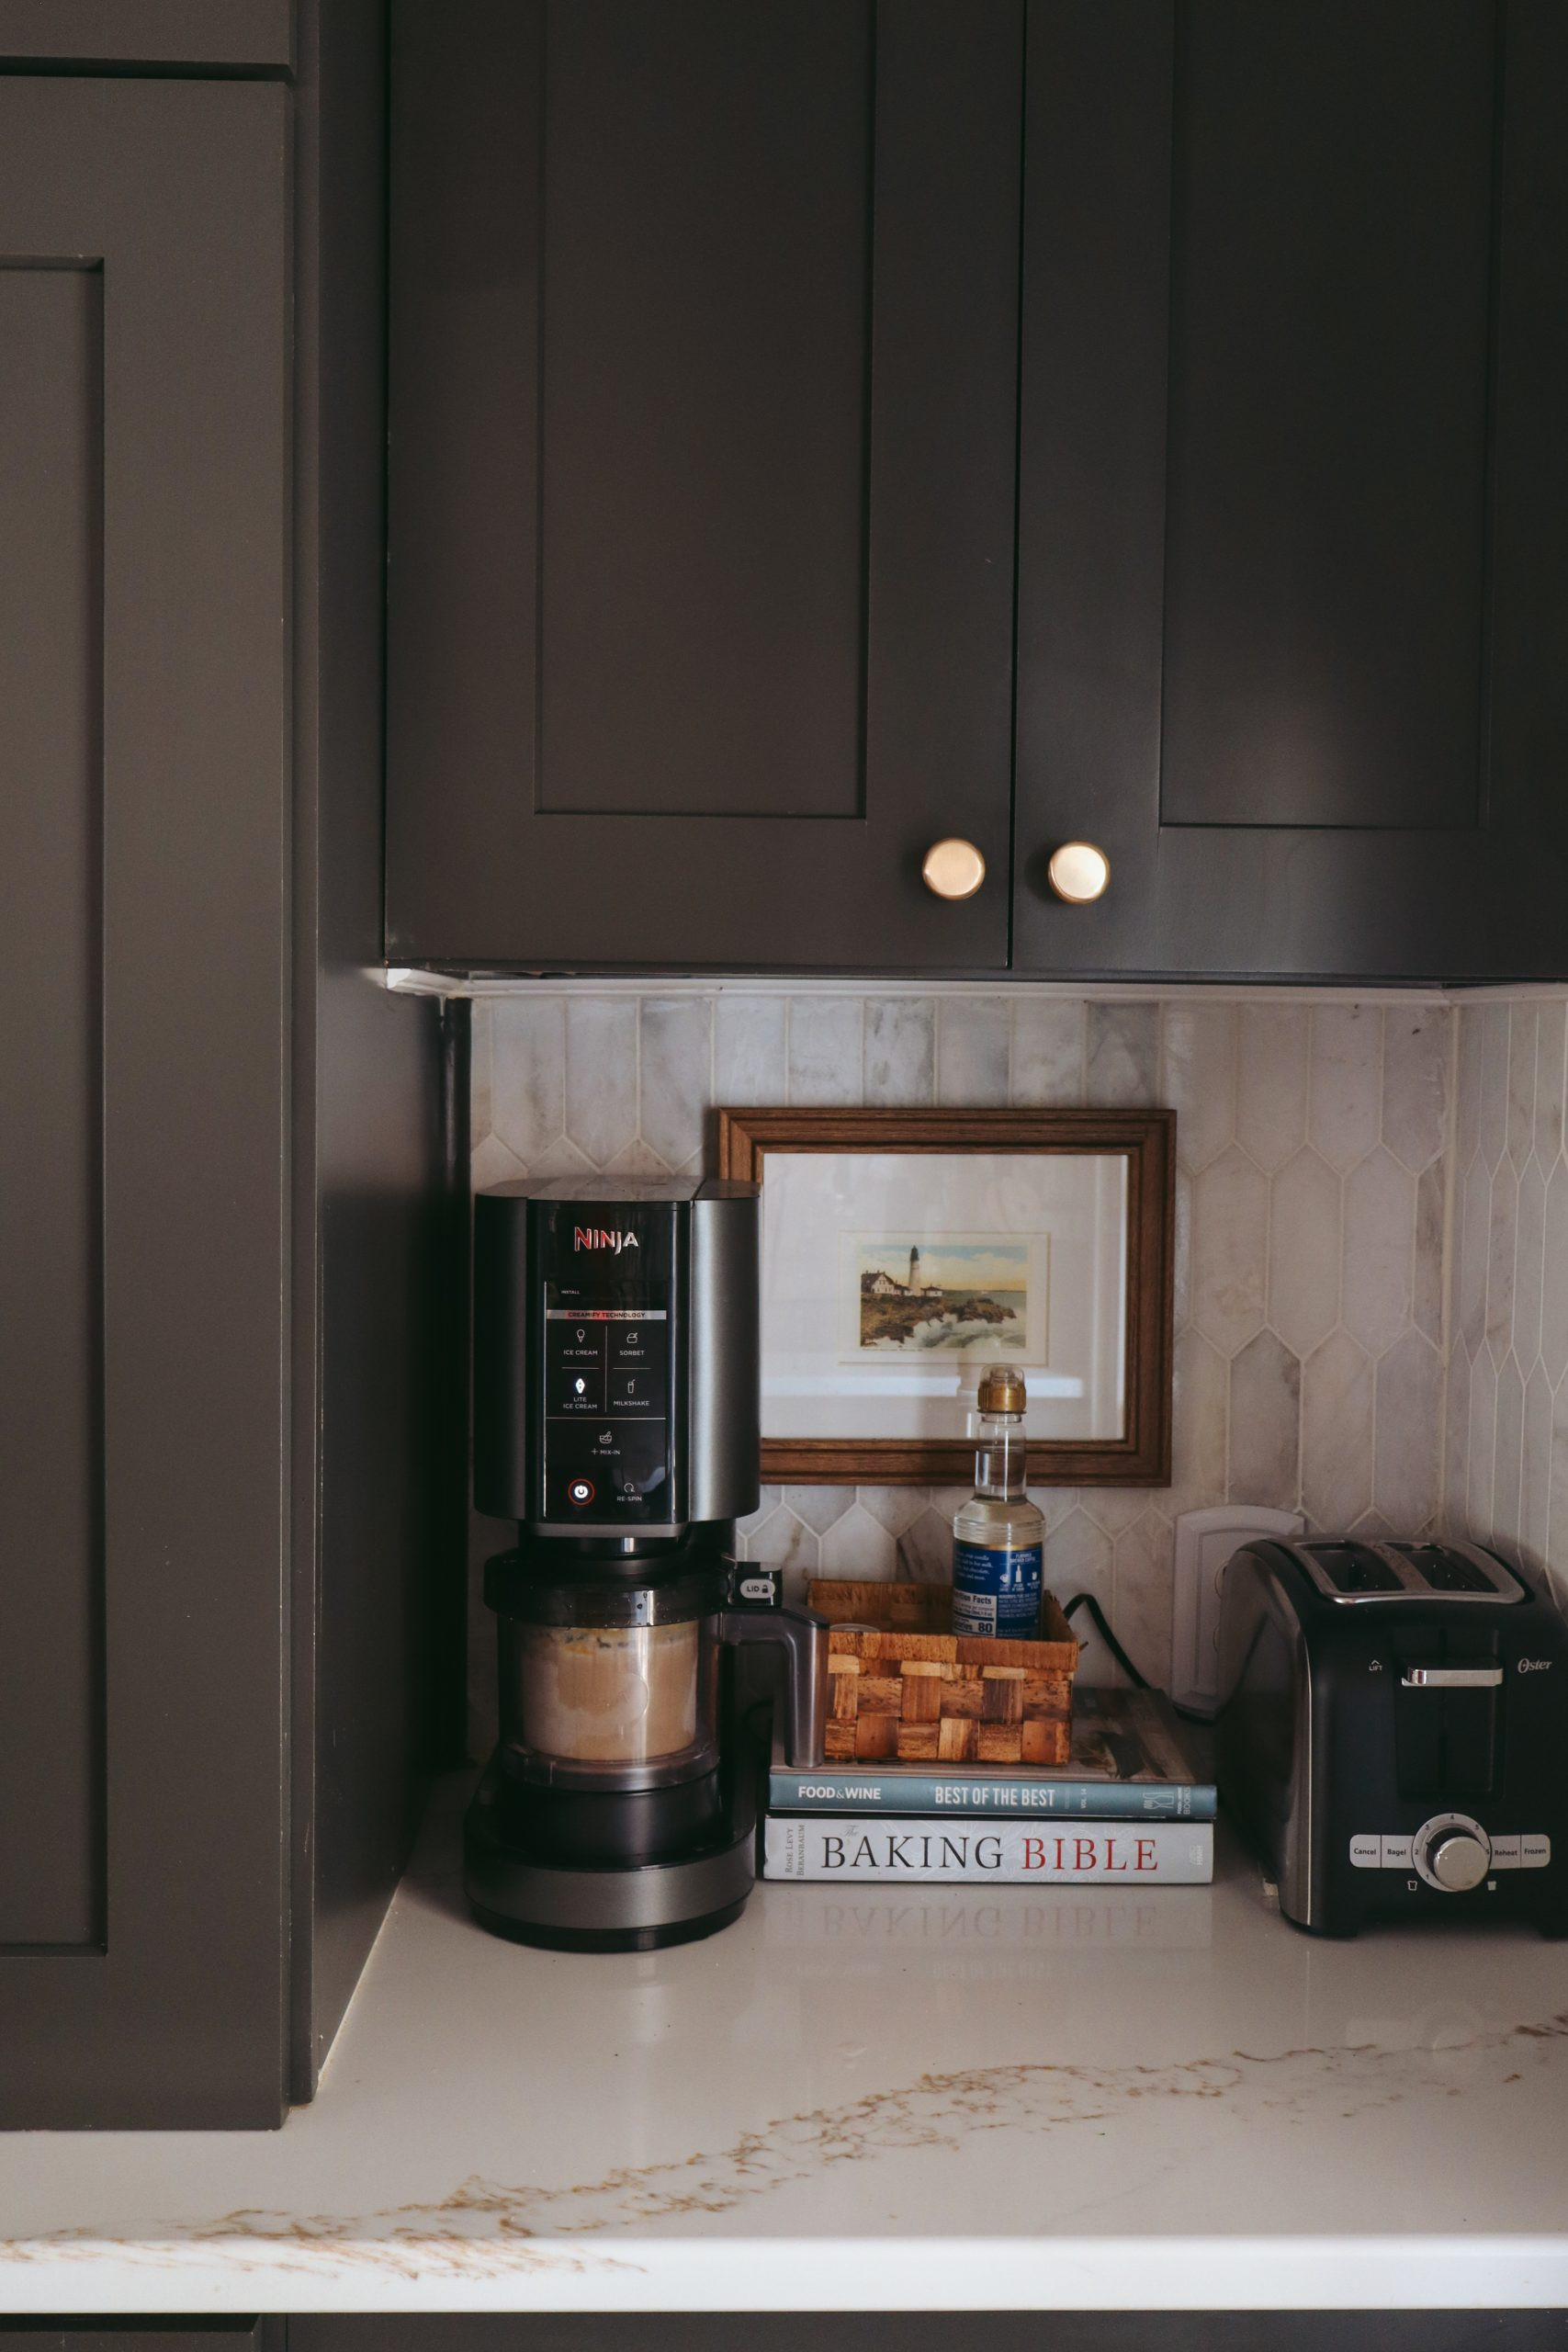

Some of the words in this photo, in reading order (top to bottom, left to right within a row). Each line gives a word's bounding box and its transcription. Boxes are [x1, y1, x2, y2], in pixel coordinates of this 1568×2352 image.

[574, 1227, 639, 1256] NINJA
[973, 1595, 992, 1605] Facts
[977, 1623, 993, 1634] 80
[1517, 1657, 1552, 1673] Oster
[934, 1786, 968, 1804] BEST
[972, 1787, 987, 1805] OF
[992, 1788, 1017, 1806] THE
[1021, 1789, 1055, 1807] BEST
[785, 1827, 794, 1849] LEVY
[844, 1825, 860, 1837] The
[796, 1824, 805, 1876] BERANBAUM
[820, 1836, 1004, 1869] BAKING
[1021, 1838, 1159, 1871] BIBLE
[785, 1852, 794, 1873] ROSE
